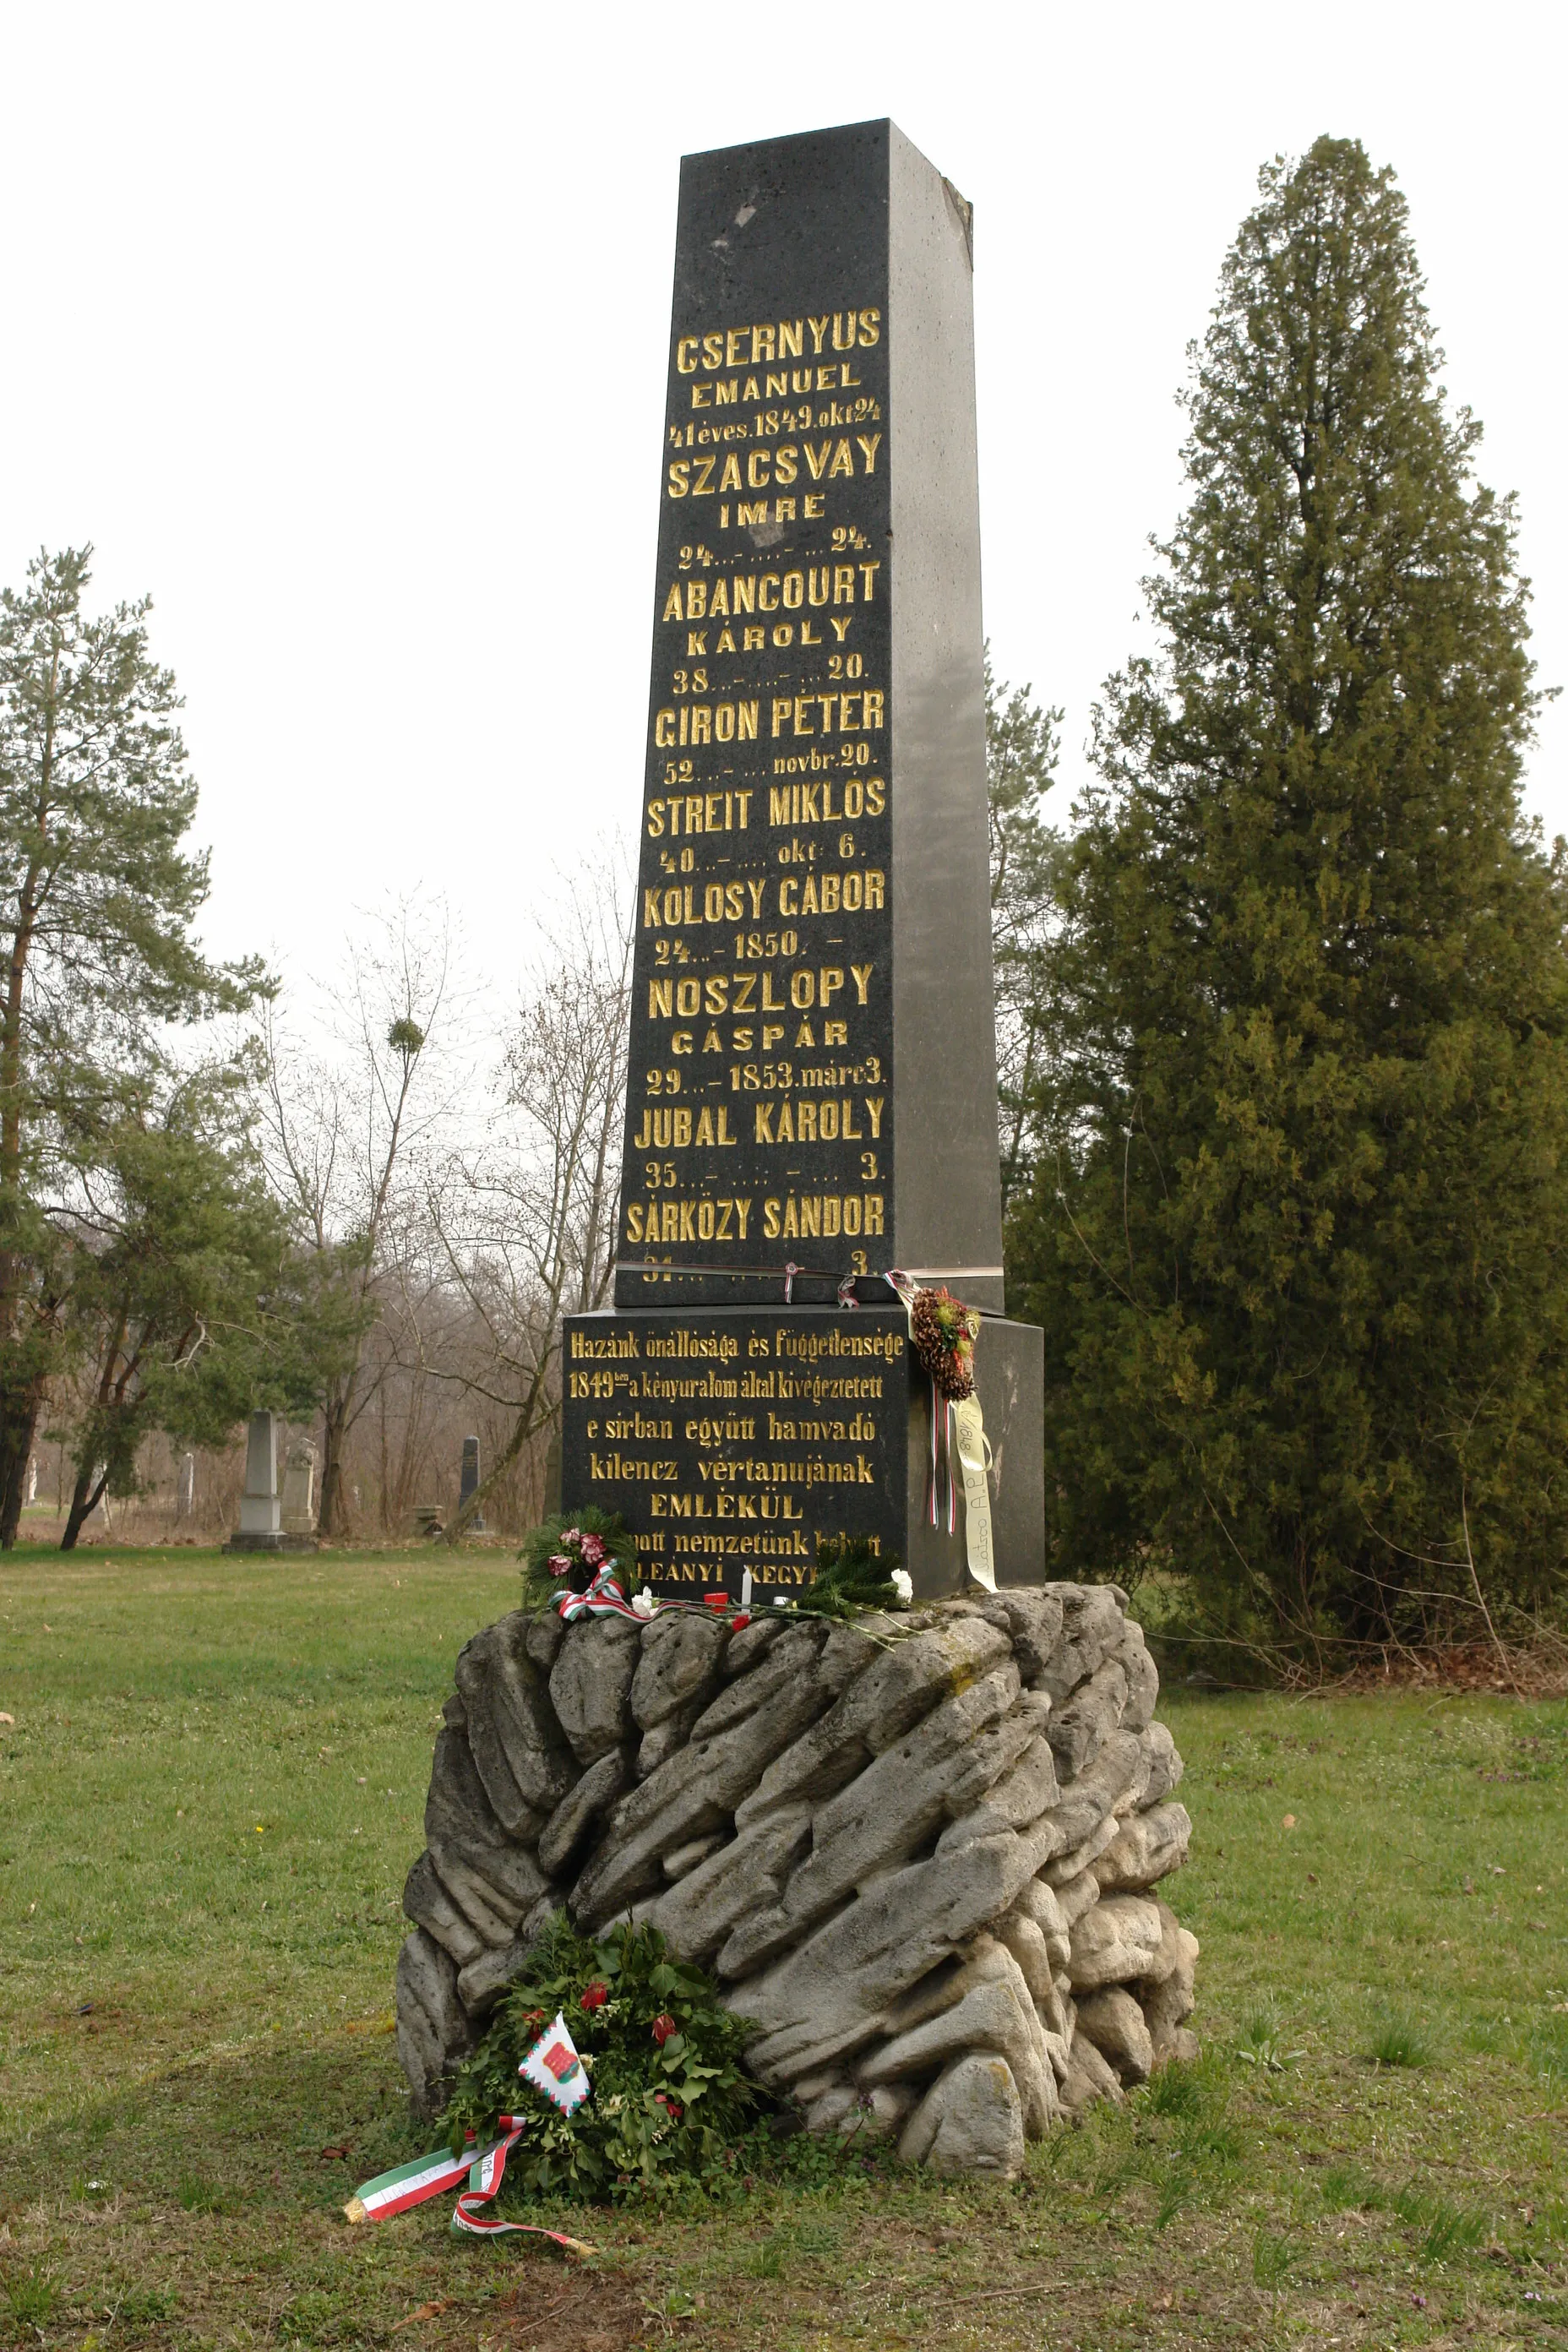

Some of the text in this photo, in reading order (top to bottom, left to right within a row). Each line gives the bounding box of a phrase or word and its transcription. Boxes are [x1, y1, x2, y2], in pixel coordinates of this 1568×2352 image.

[677, 308, 880, 374] CSERNYUS
[692, 362, 861, 409] EMANUEL
[668, 433, 882, 498] SZACSVAY
[720, 493, 825, 528] IMRE
[662, 561, 880, 622] ABANCOURT
[687, 617, 852, 656] KÁROLY
[655, 688, 885, 748] GIRON PÉTER
[647, 770, 885, 837] STREIT MIKLÓS
[644, 865, 885, 928] KOLOSY GÁBOR
[648, 964, 874, 1020] NOSZLOPY
[671, 1015, 848, 1054] GÁSPÁR
[634, 1092, 885, 1150] JUBAL KÁROLY
[626, 1187, 884, 1244] SÁRKÖZY SÁNDOR
[570, 1327, 904, 1365] Hazánk önállósága és függetlensége
[629, 1378, 640, 1397] a
[640, 1369, 738, 1403] kényuralom
[587, 1419, 599, 1439] e
[685, 1410, 756, 1448] együtt
[766, 1412, 875, 1441] hamvadó
[590, 1452, 875, 1489] kilencz vértanujának
[651, 1486, 803, 1520] EMLÉKÜL
[674, 1529, 809, 1556] nemzetünk
